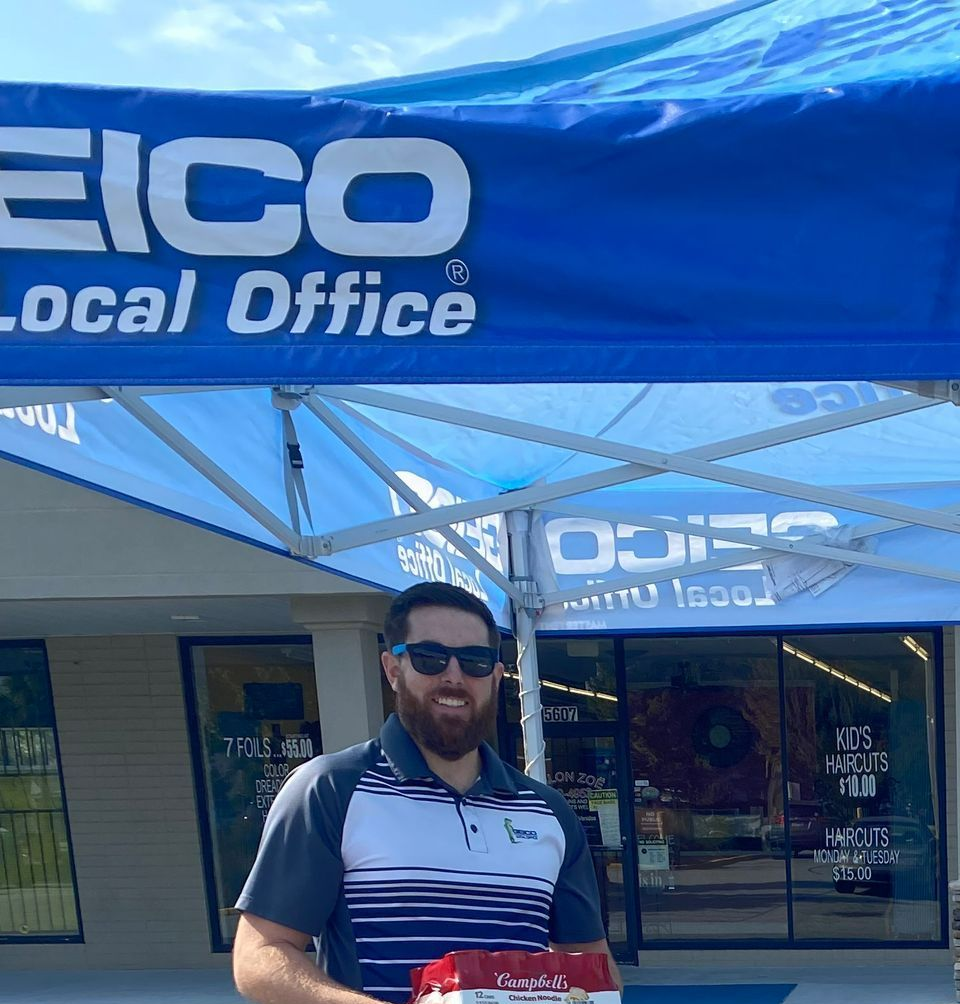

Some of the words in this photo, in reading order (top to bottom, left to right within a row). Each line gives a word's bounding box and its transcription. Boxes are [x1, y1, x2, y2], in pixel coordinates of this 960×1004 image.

[226, 269, 476, 336] Office
[543, 706, 578, 722] 5607
[223, 737, 234, 758] 7
[236, 736, 272, 758] FOILS
[836, 725, 872, 751] KID'S
[263, 763, 290, 778] COLOR
[825, 752, 889, 775] HAIRCUTS
[839, 774, 877, 797] $10.00
[825, 827, 889, 847] HAIRCUTS
[813, 849, 850, 864] MONDAY
[861, 849, 900, 865] TUESDAY
[832, 867, 872, 883] $15.00
[494, 972, 568, 992] Campbell's
[475, 991, 484, 999] 12
[508, 994, 537, 1002] Chicken
[537, 994, 562, 1002] Noodle
